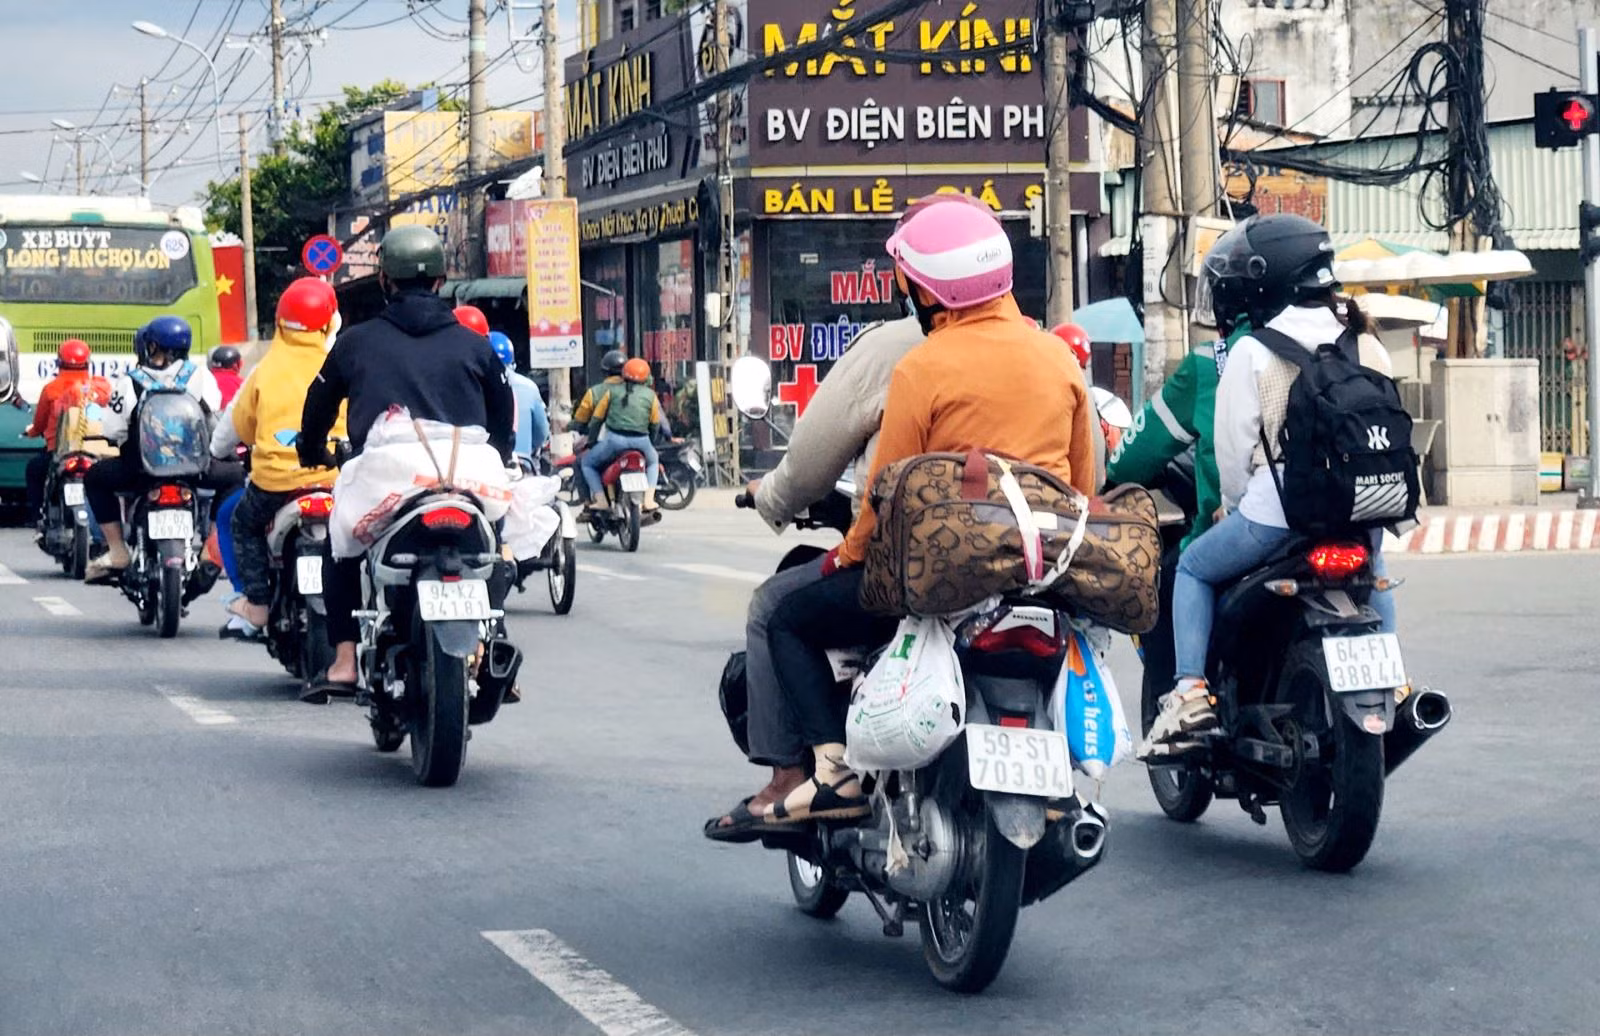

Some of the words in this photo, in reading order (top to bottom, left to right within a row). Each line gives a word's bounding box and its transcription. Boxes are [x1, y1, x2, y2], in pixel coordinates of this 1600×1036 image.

[608, 42, 650, 126] KÍNH
[767, 108, 811, 141] BV
[827, 98, 904, 148] ĐIỆN
[917, 97, 991, 139] BIÊN
[1003, 105, 1044, 138] PH
[582, 156, 595, 187] BV
[598, 142, 620, 188] ĐIỆN
[623, 134, 644, 176] BIÊN
[764, 183, 835, 213] BÁN
[854, 179, 894, 212] LẺ
[22, 230, 53, 249] XE
[55, 227, 111, 249] BUÝT
[831, 259, 894, 304] MẮT
[770, 324, 804, 360] BV
[975, 758, 1065, 792] 703.94
